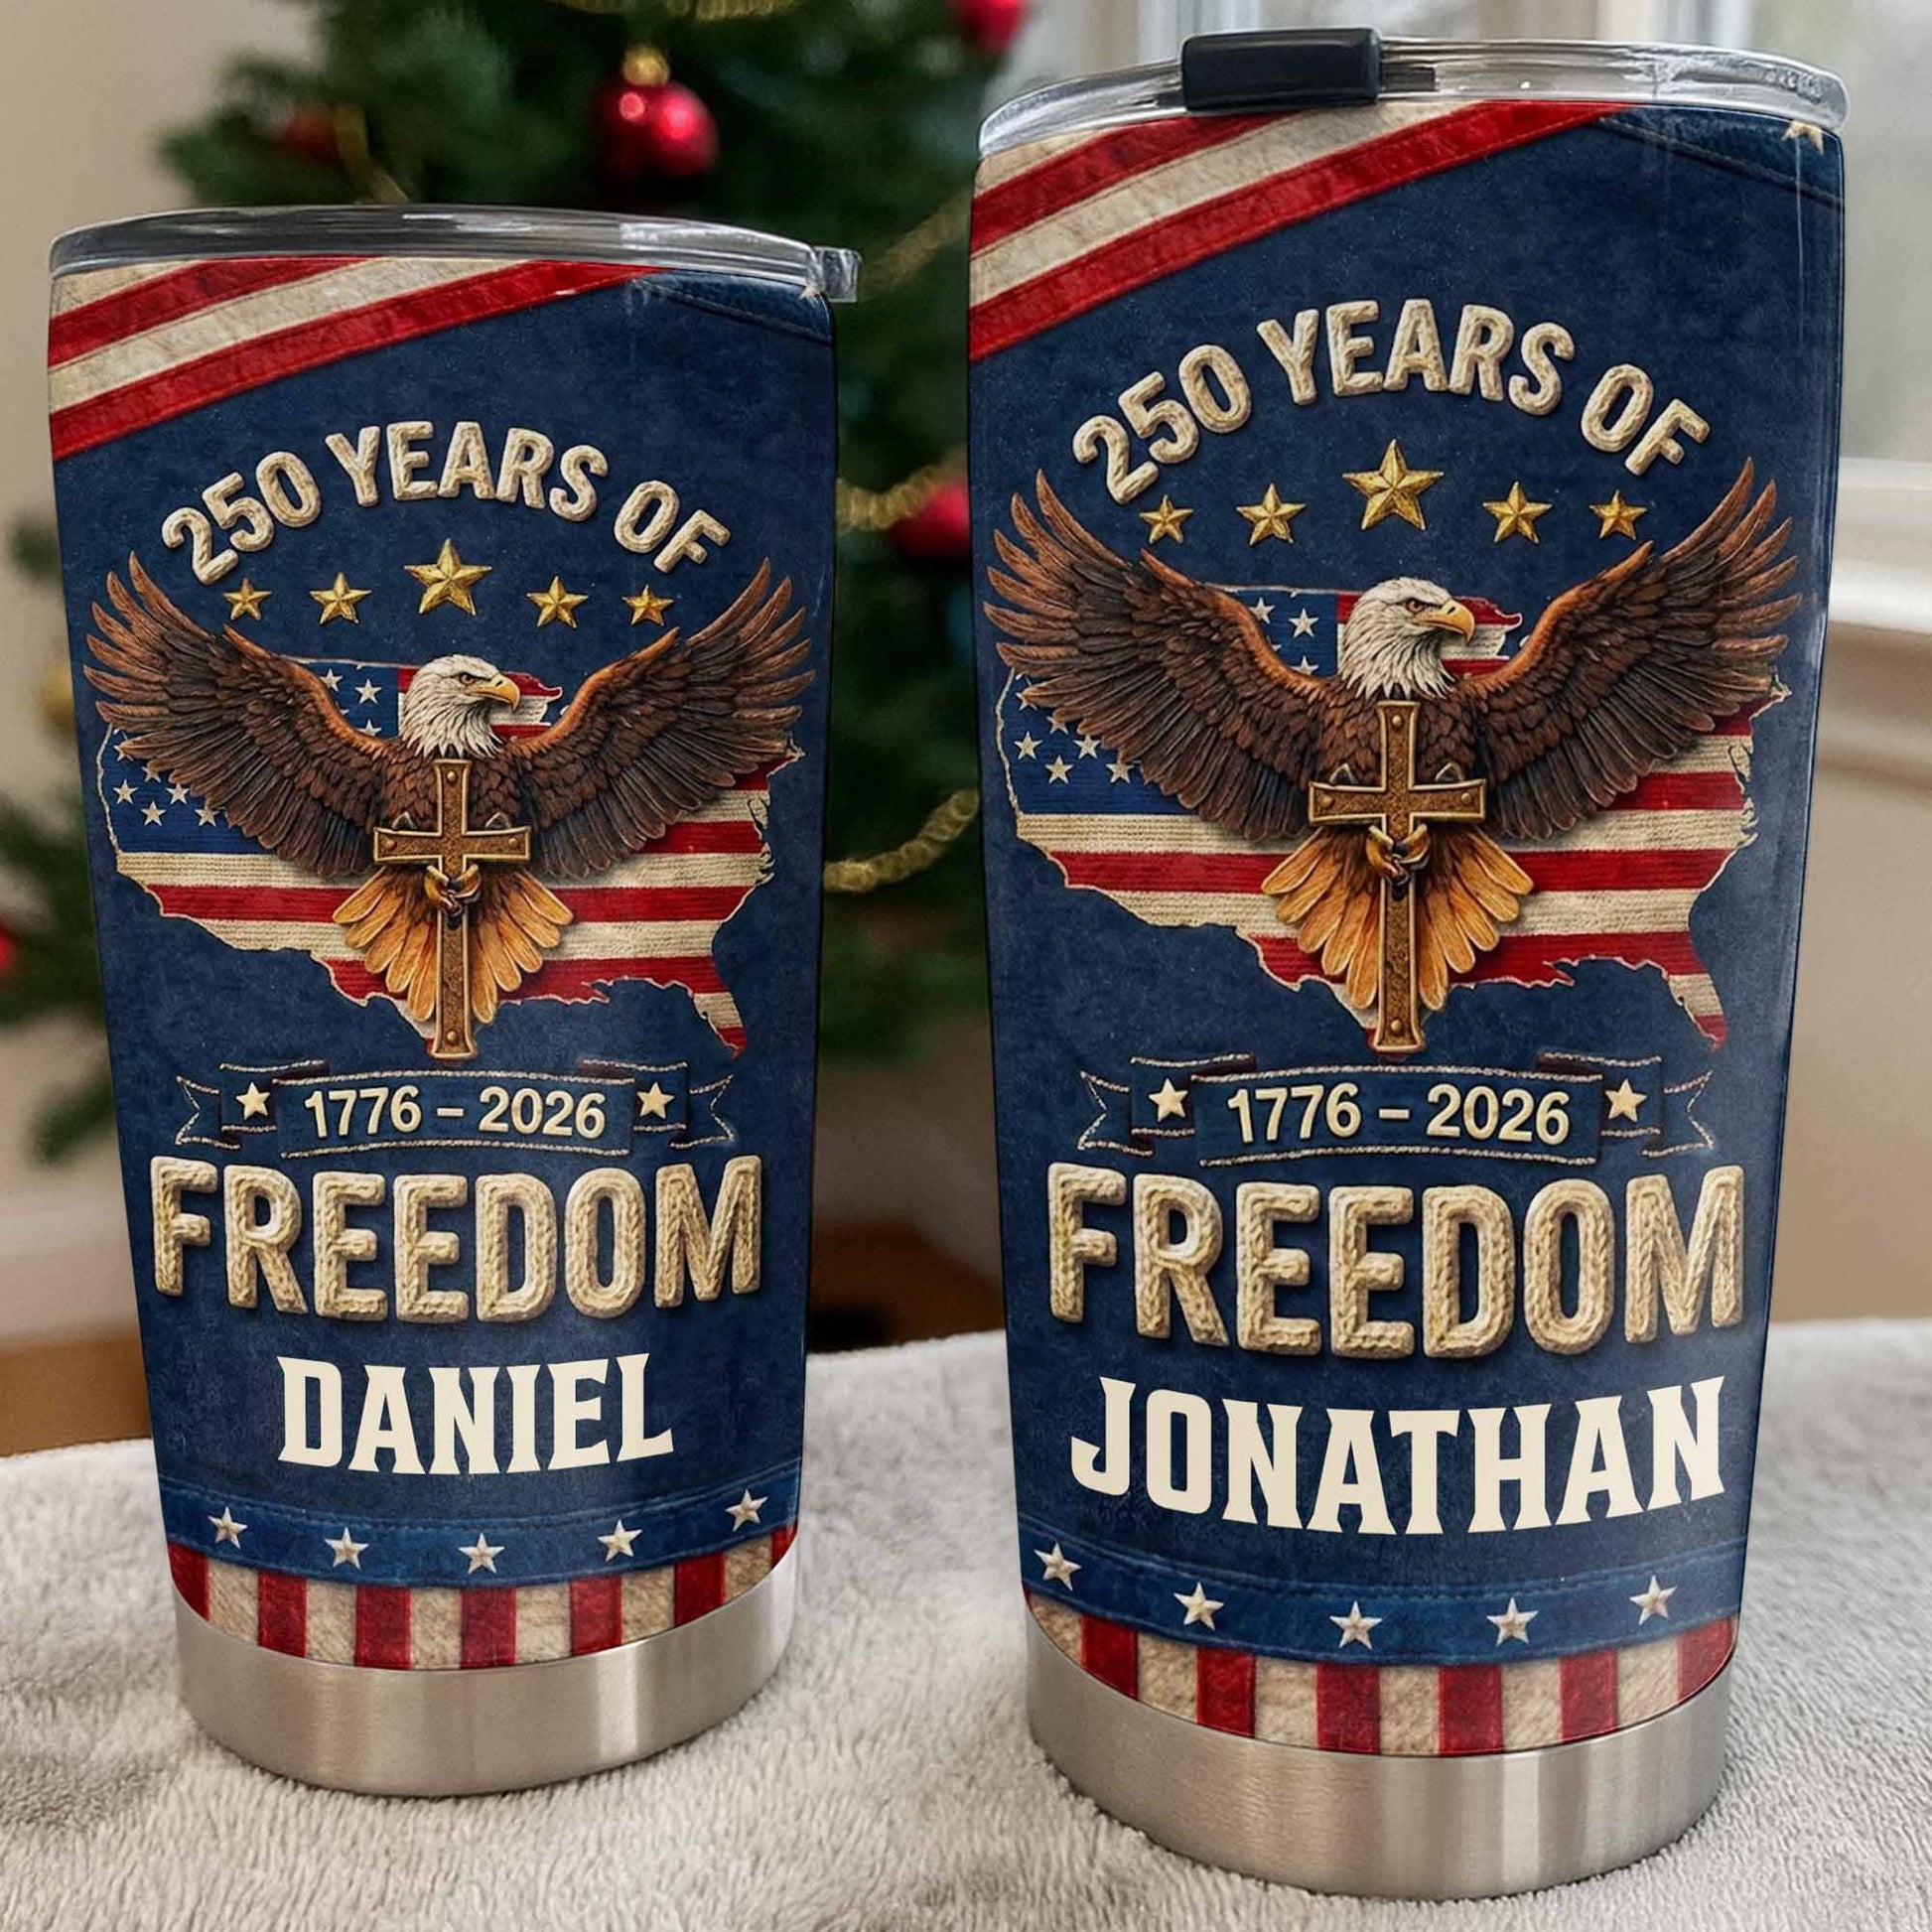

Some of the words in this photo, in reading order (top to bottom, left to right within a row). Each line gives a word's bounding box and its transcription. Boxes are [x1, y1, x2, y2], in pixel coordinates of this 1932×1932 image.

[1073, 345, 1251, 504] 250
[1258, 298, 1575, 416] YEARS
[1581, 364, 1710, 476] OF
[161, 450, 322, 585] 250
[326, 421, 609, 521] YEARS
[613, 481, 731, 574] OF
[305, 1086, 422, 1138] 1776
[480, 1086, 607, 1138] 2026
[1228, 1082, 1361, 1142] 1776
[1426, 1083, 1570, 1143] 2026
[150, 1155, 761, 1322] FREEDOM
[1047, 1162, 1744, 1358] FREEDOM
[277, 1353, 672, 1474] DANIEL
[1071, 1376, 1725, 1535] JONATHAN
